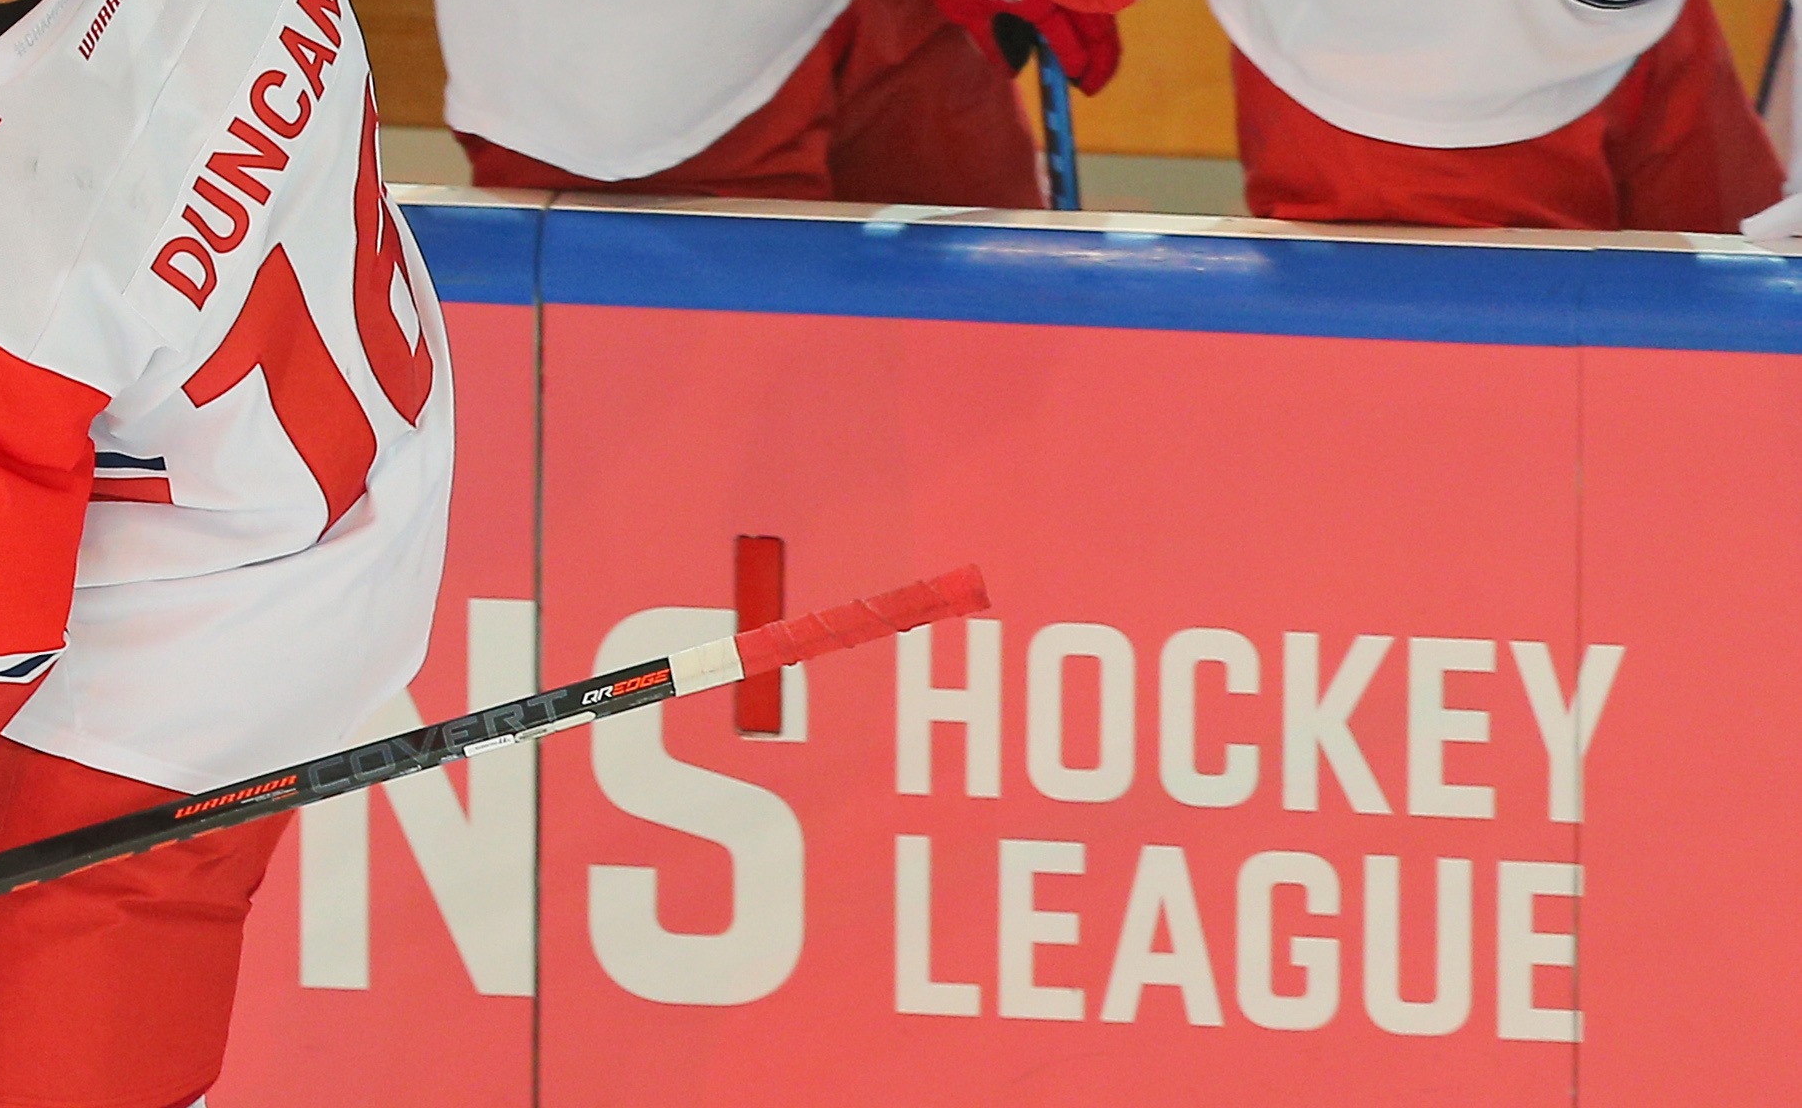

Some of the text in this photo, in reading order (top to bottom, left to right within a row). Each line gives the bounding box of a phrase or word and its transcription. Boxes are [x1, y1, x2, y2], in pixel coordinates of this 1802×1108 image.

[181, 71, 434, 544] 16
[174, 774, 298, 820] WARRIOR
[308, 688, 569, 796] COVERT
[895, 618, 1626, 824] HOCKEY
[895, 834, 1586, 1044] LEAGUE
